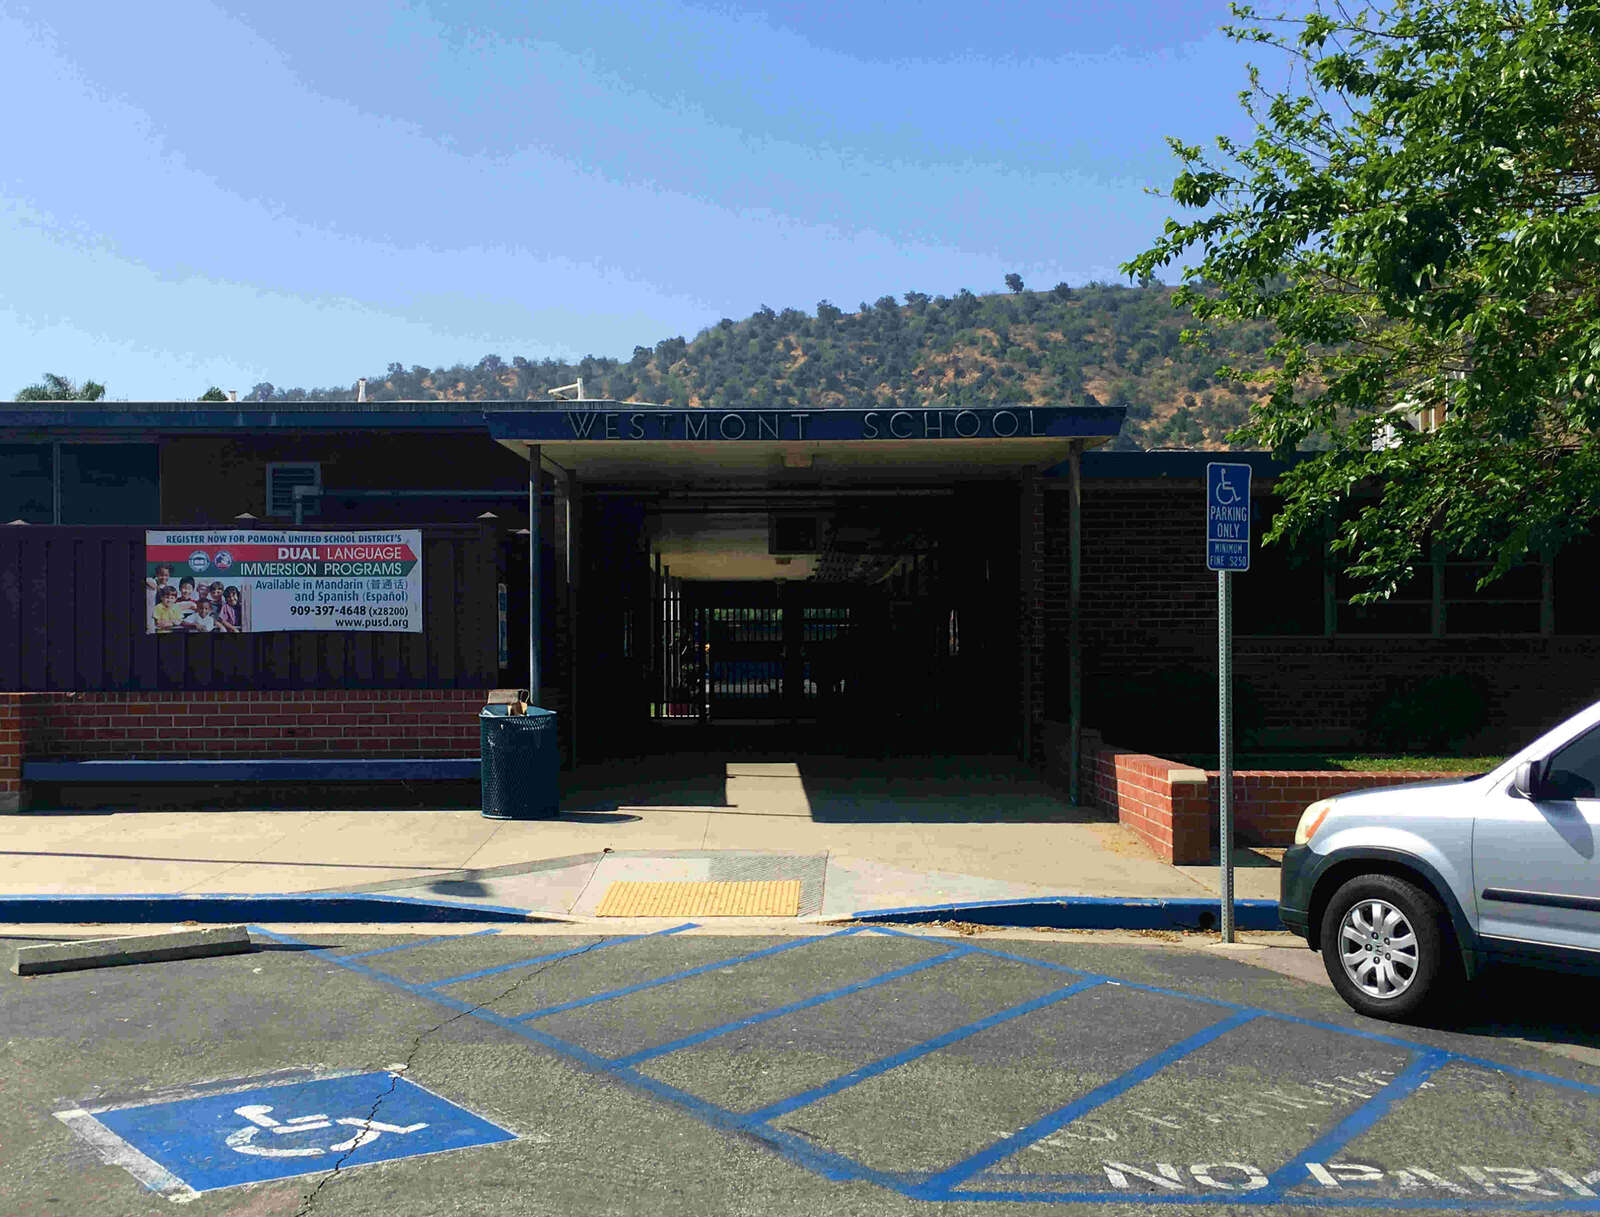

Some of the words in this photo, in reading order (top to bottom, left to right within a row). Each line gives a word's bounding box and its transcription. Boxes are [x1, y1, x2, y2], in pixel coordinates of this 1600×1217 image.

[567, 413, 810, 440] WESTMONT
[863, 410, 1047, 439] SCHOOL
[1210, 505, 1247, 522] PARKING
[1217, 522, 1240, 539] ONLY
[166, 535, 205, 544] REGISTER
[207, 535, 228, 544] NOW
[229, 535, 245, 544] FOR
[247, 535, 285, 544] POMONA
[288, 535, 321, 543] UNIFIED
[324, 535, 356, 543] SCHOOL
[358, 534, 402, 543] DISTRICT'S
[278, 547, 320, 560] DUAL
[327, 546, 401, 560] LANGUAGE
[1215, 543, 1243, 554] MINIMUM
[240, 562, 317, 576] IMMERSION
[324, 562, 402, 575] PROGRAMS
[255, 579, 300, 590] Available
[303, 579, 312, 590] in
[315, 579, 363, 590] Mandarin
[295, 591, 315, 602] and
[318, 591, 359, 604] Spanish
[362, 591, 408, 604] (Español)
[290, 605, 366, 616] 909-397-4648
[368, 607, 409, 617] (x28200)
[335, 618, 409, 629] www.pusd.org
[1101, 1159, 1268, 1190] NO
